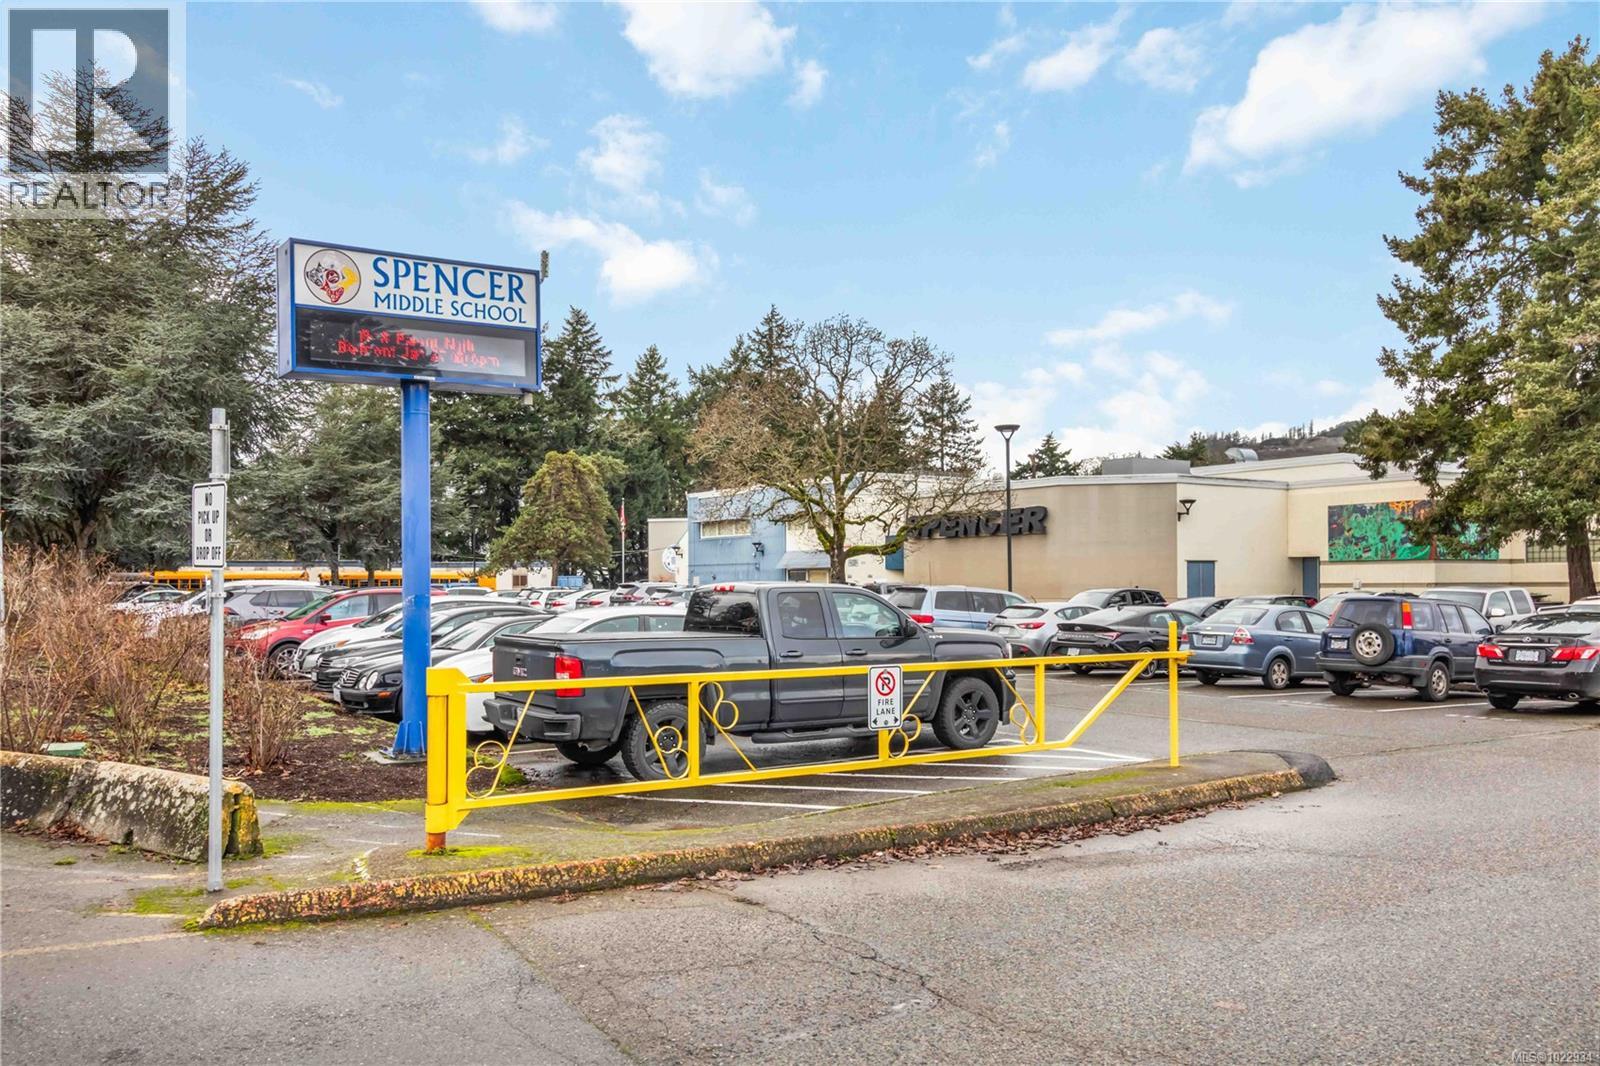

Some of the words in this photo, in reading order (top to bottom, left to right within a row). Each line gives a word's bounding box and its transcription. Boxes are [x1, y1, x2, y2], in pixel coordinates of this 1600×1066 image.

[372, 256, 528, 304] SPENCER
[373, 291, 443, 316] MIDDLE
[451, 300, 527, 324] SCHOOL
[205, 492, 213, 506] NO
[197, 510, 210, 525] PICK
[211, 510, 220, 524] UP
[204, 528, 212, 542] OR
[196, 546, 210, 560] DROP
[211, 546, 221, 560] OFF
[877, 698, 894, 706] FIRE
[876, 707, 896, 716] LANE
